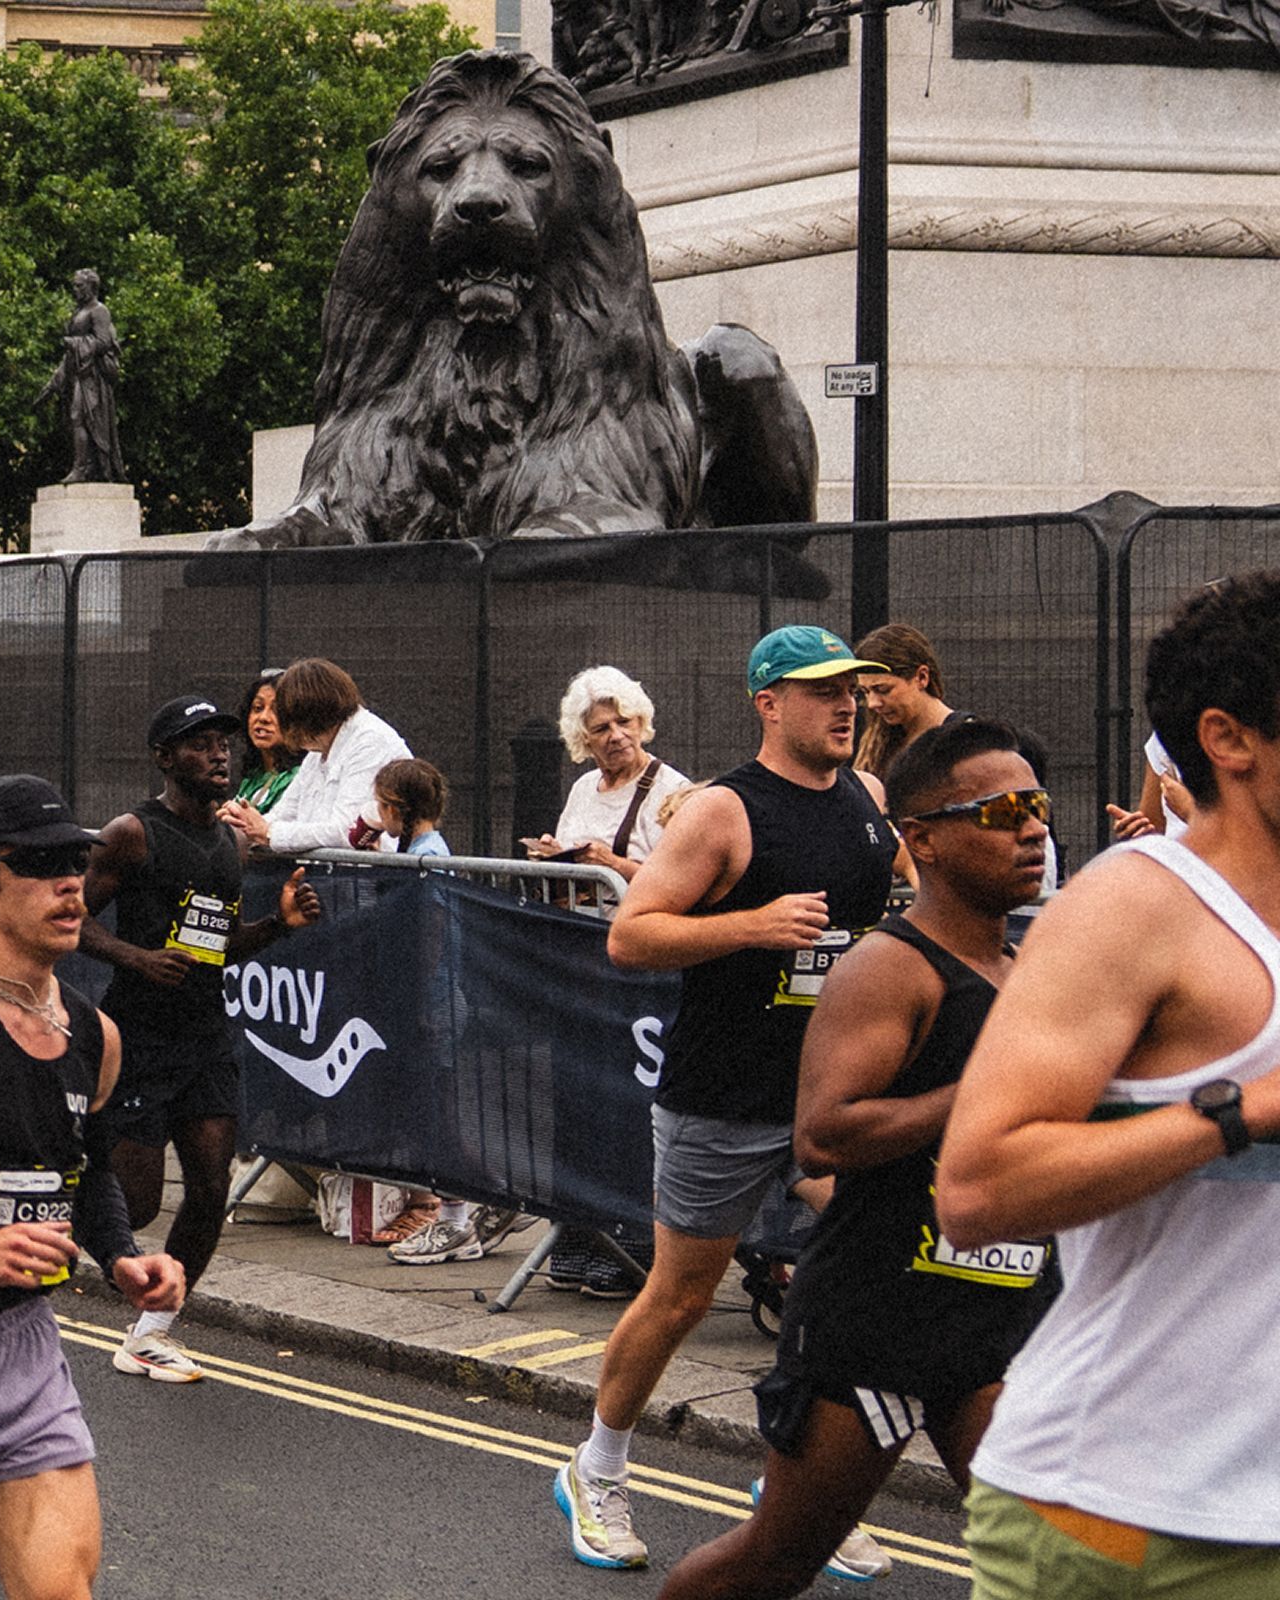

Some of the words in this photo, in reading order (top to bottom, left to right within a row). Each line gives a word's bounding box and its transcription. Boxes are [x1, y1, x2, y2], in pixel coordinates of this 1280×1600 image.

[201, 914, 209, 926] B
[817, 953, 830, 968] B
[17, 1202, 34, 1222] C
